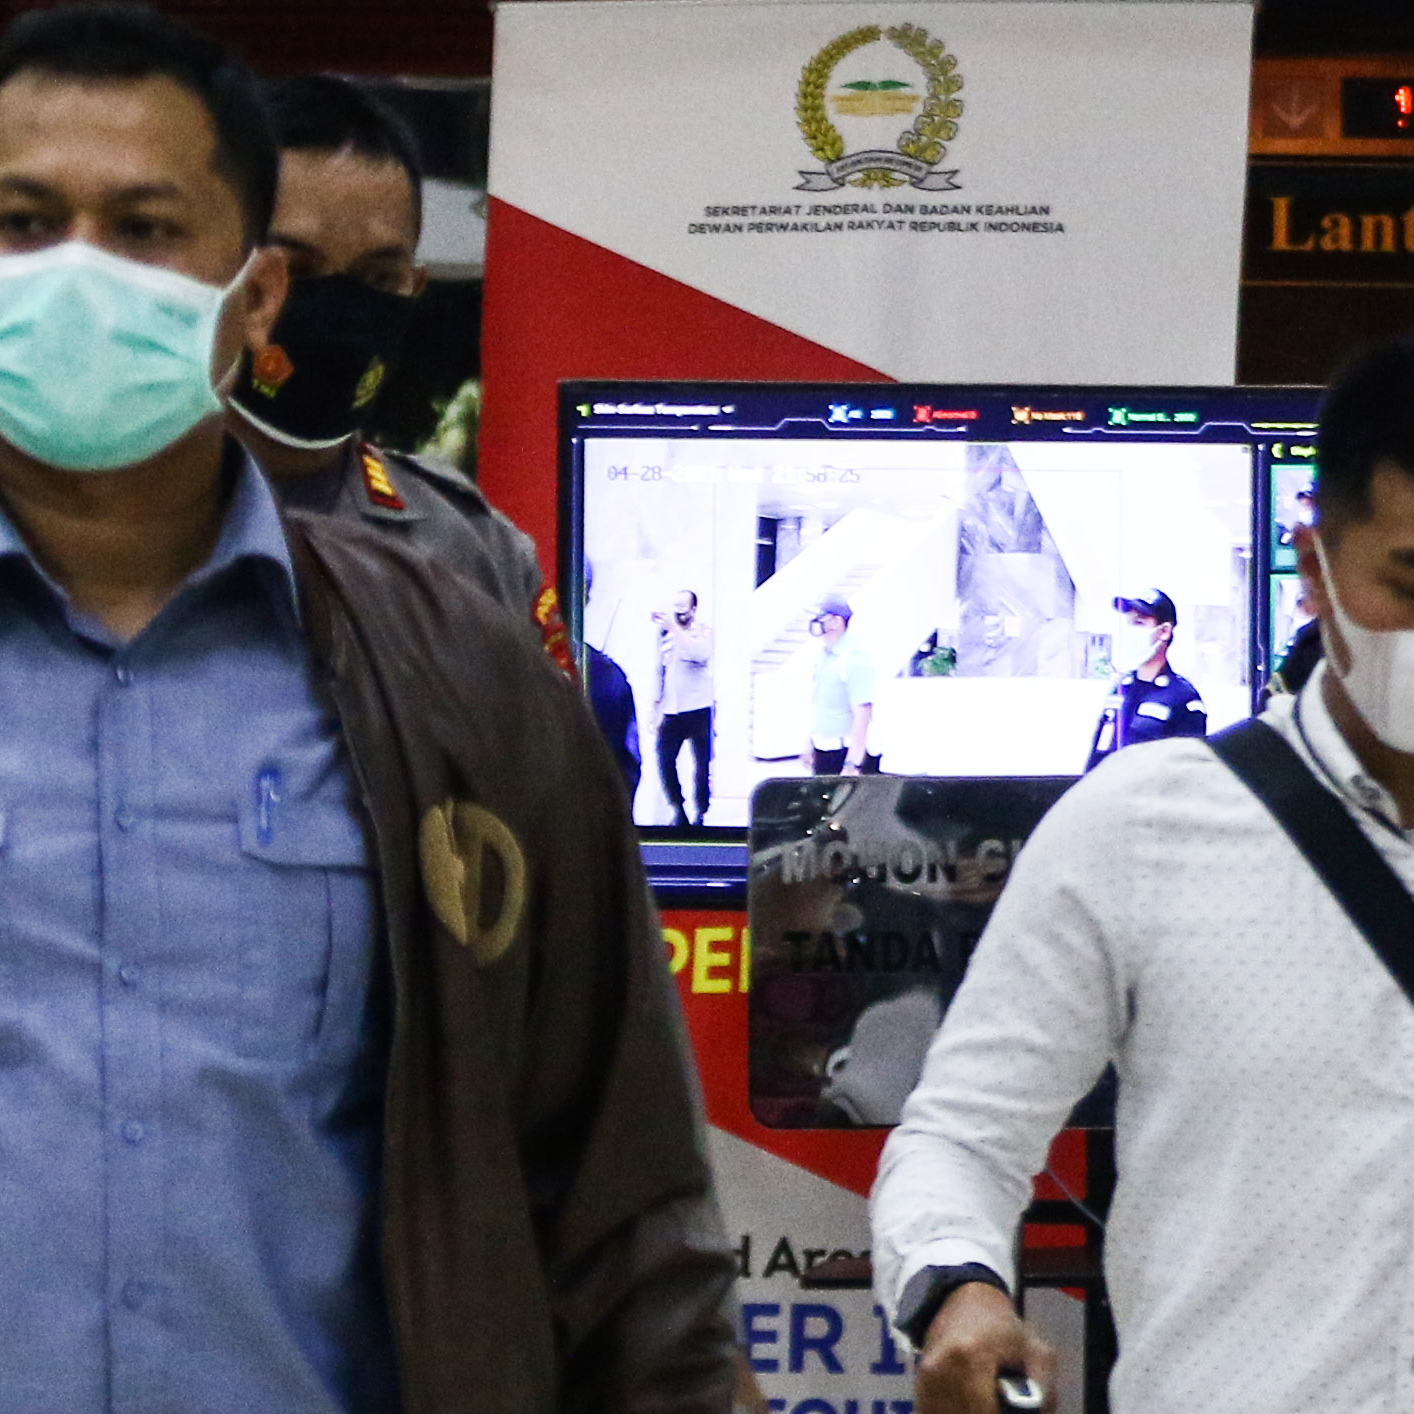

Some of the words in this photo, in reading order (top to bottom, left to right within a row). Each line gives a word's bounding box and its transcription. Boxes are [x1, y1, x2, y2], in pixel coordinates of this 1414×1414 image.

[704, 205, 802, 217] SEKRETARIAT
[806, 203, 878, 216] JENDERAL
[882, 203, 915, 215] DAN
[919, 203, 972, 216] BADAN
[975, 205, 1050, 216] KEAHLIAN
[688, 222, 743, 234] DEWAN
[747, 221, 843, 233] PERWAKILAN
[847, 219, 904, 232] RAKYAT
[909, 221, 979, 233] REPUBLIK
[983, 221, 1065, 234] INDONESIA
